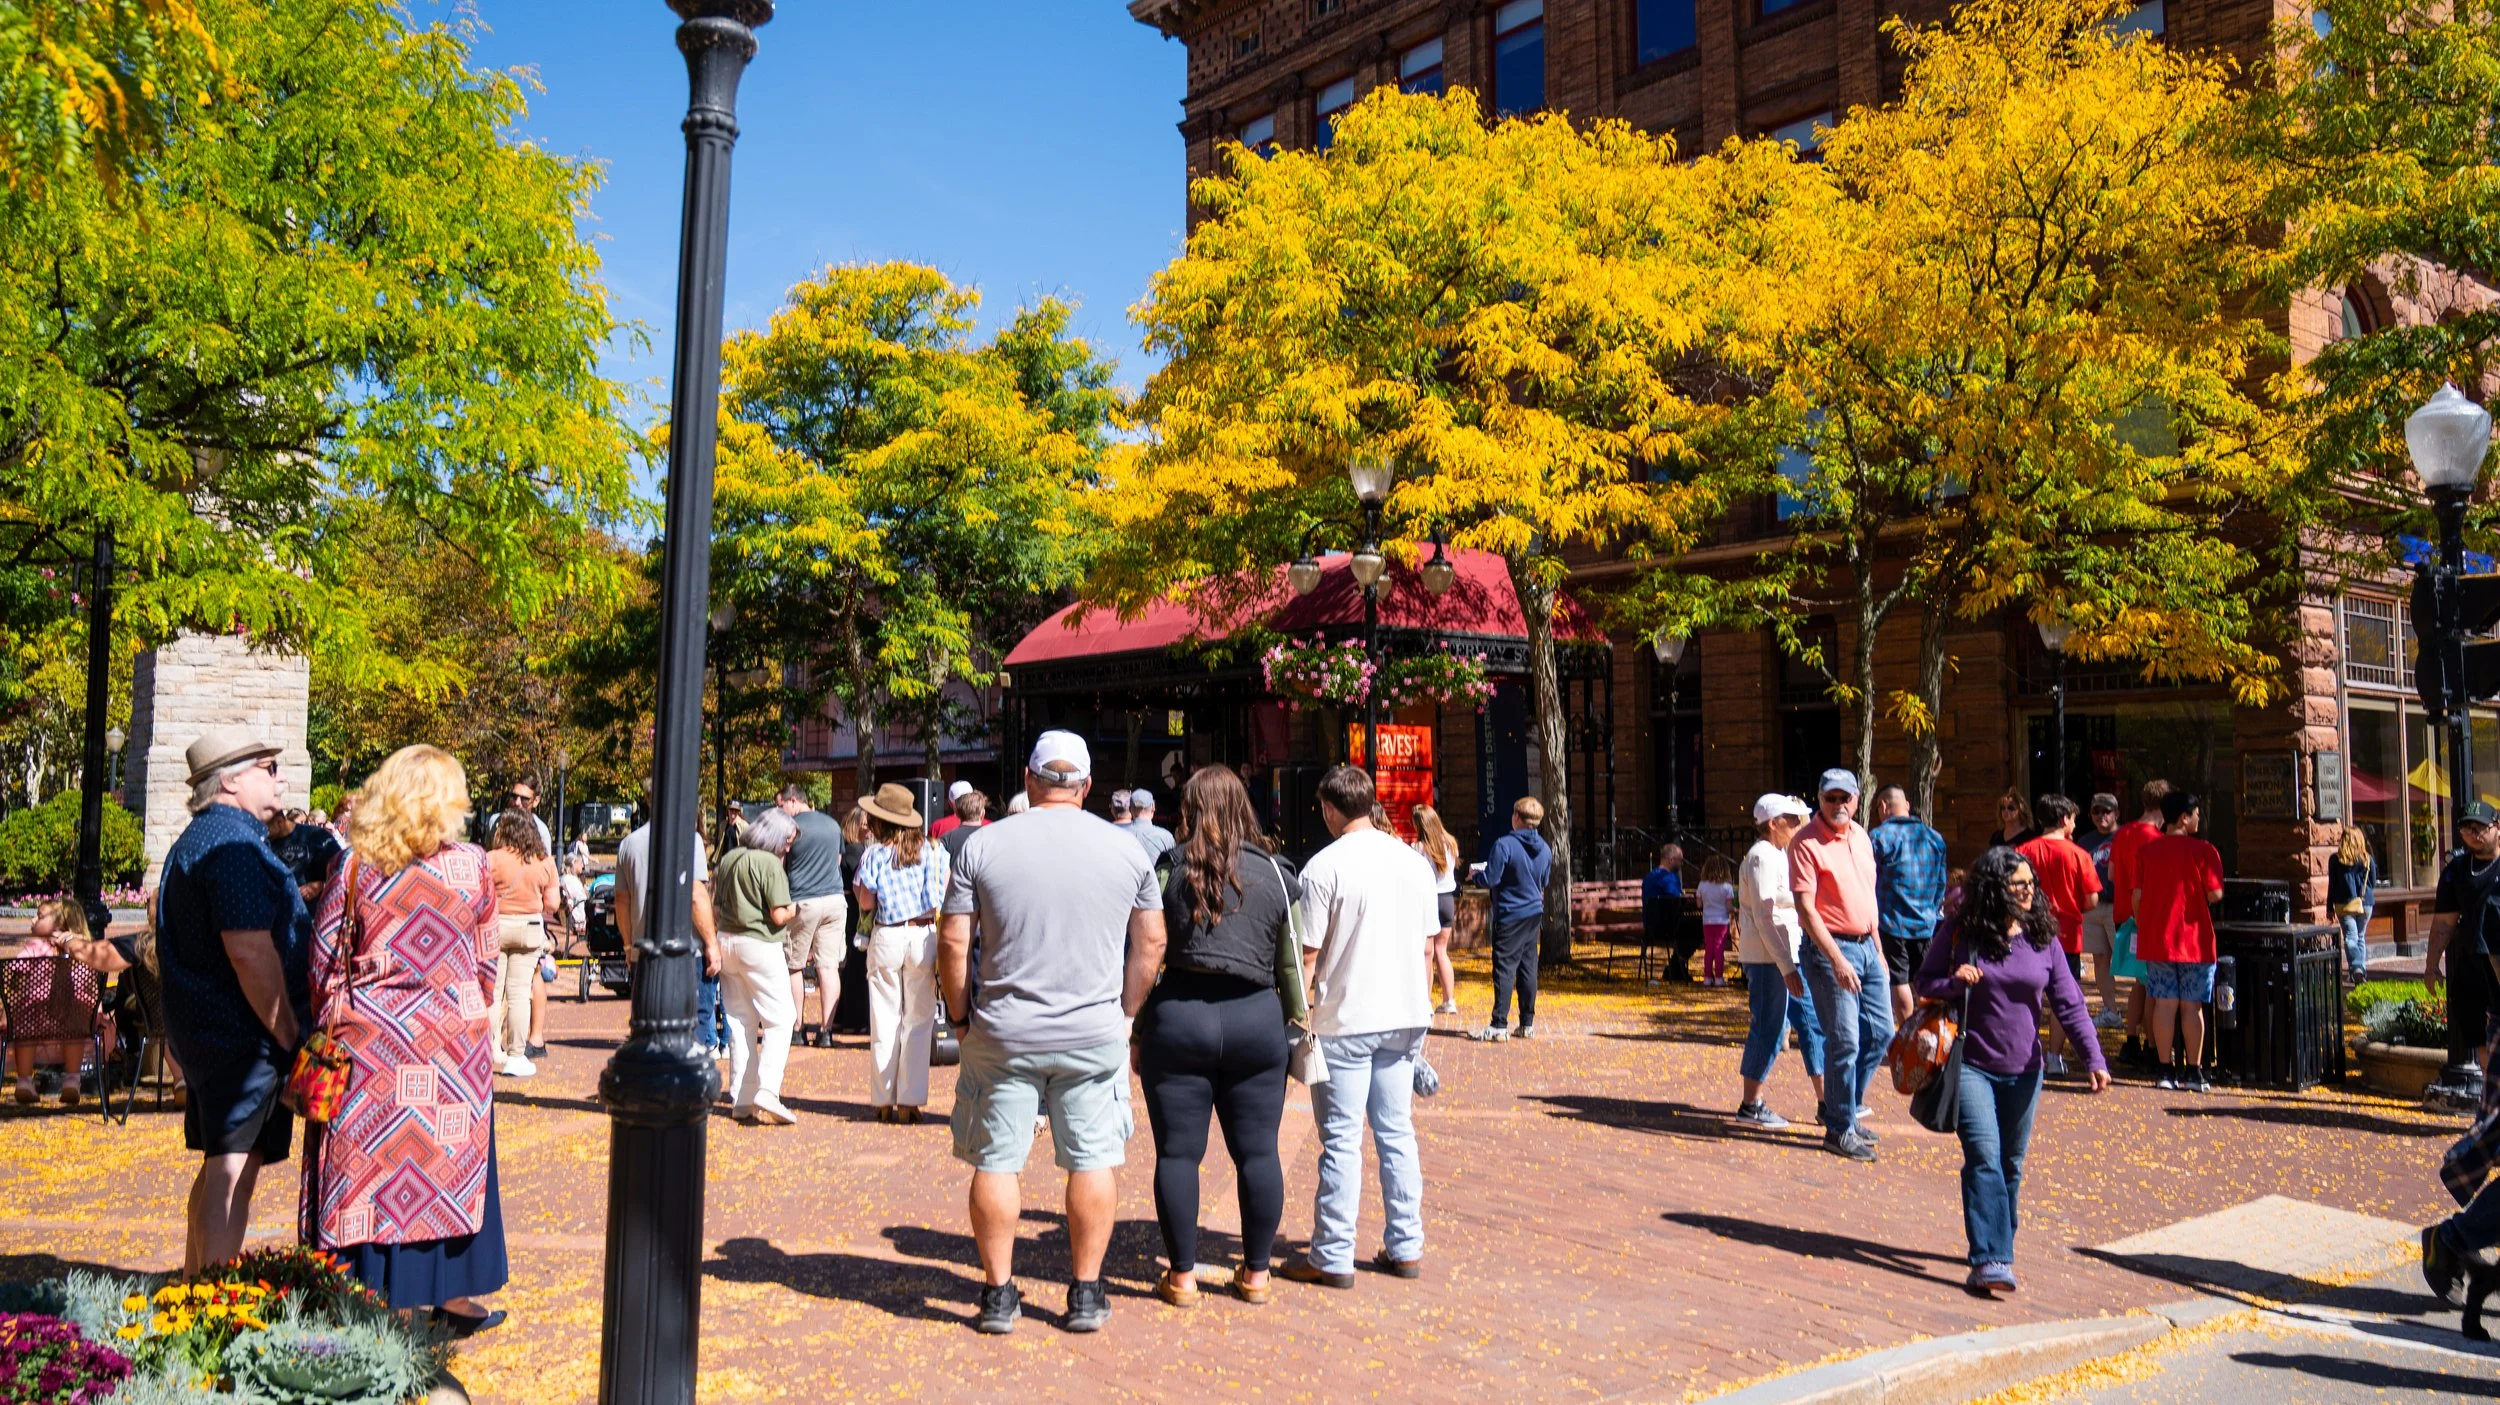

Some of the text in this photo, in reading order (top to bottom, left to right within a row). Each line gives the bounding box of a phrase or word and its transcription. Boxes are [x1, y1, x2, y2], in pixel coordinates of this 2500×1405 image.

[1376, 733, 1419, 757] ARVEST
[1484, 702, 1496, 814] GAFFER DISTRIC
